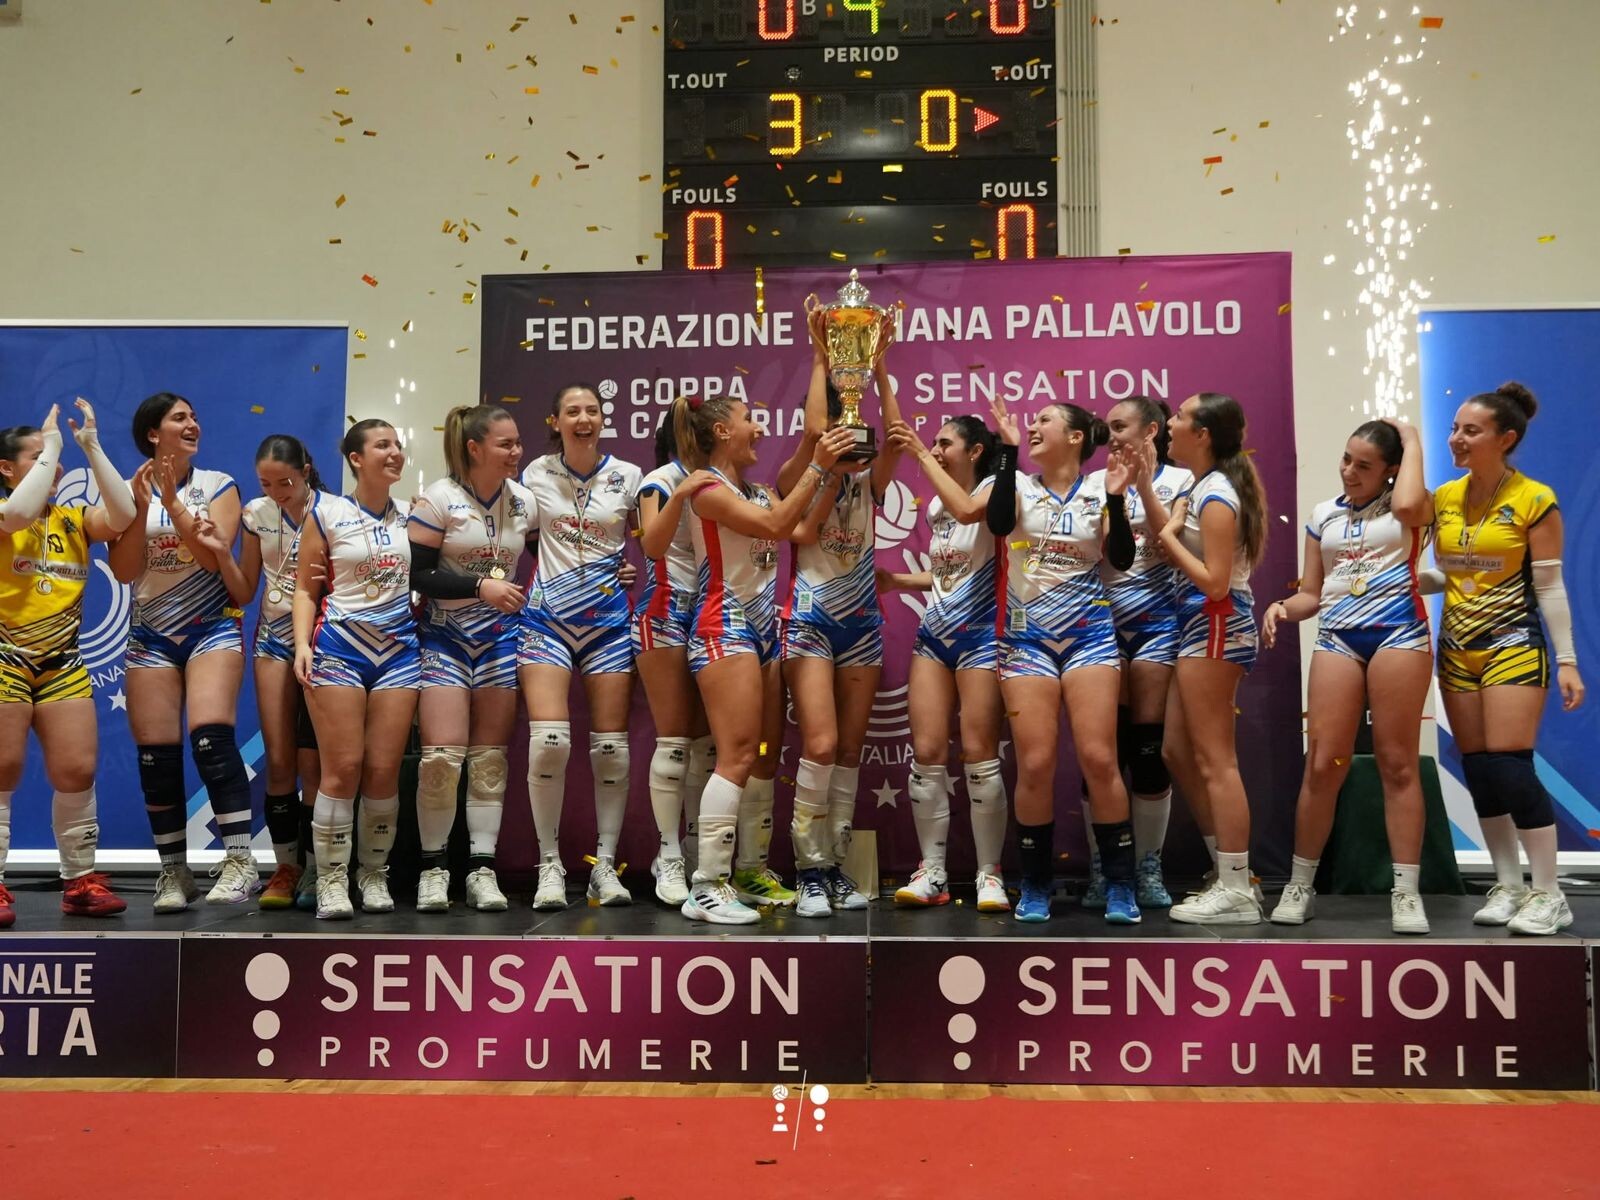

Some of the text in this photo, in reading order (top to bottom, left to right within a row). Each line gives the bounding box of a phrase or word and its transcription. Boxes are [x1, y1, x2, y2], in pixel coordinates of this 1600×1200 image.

[824, 46, 900, 63] PERIOD
[668, 73, 728, 90] T.OUT
[991, 64, 1052, 83] T.OUT
[769, 93, 801, 156] 3
[920, 90, 957, 152] 0
[672, 188, 737, 205] FOULS
[982, 181, 1049, 199] FOULS
[687, 211, 723, 270] 0
[525, 312, 794, 351] FEDERAZIONE
[1005, 300, 1242, 339] PALLAVOLO
[630, 375, 749, 406] COPPA
[914, 368, 1169, 404] SENSATION
[2, 962, 94, 995] NALE
[320, 952, 799, 1016] SENSATION
[1018, 955, 1517, 1021] SENSATION
[0, 1006, 98, 1057] IA
[320, 1036, 799, 1071] PROFUMERIE
[1018, 1040, 1519, 1078] PROFUMERIE
